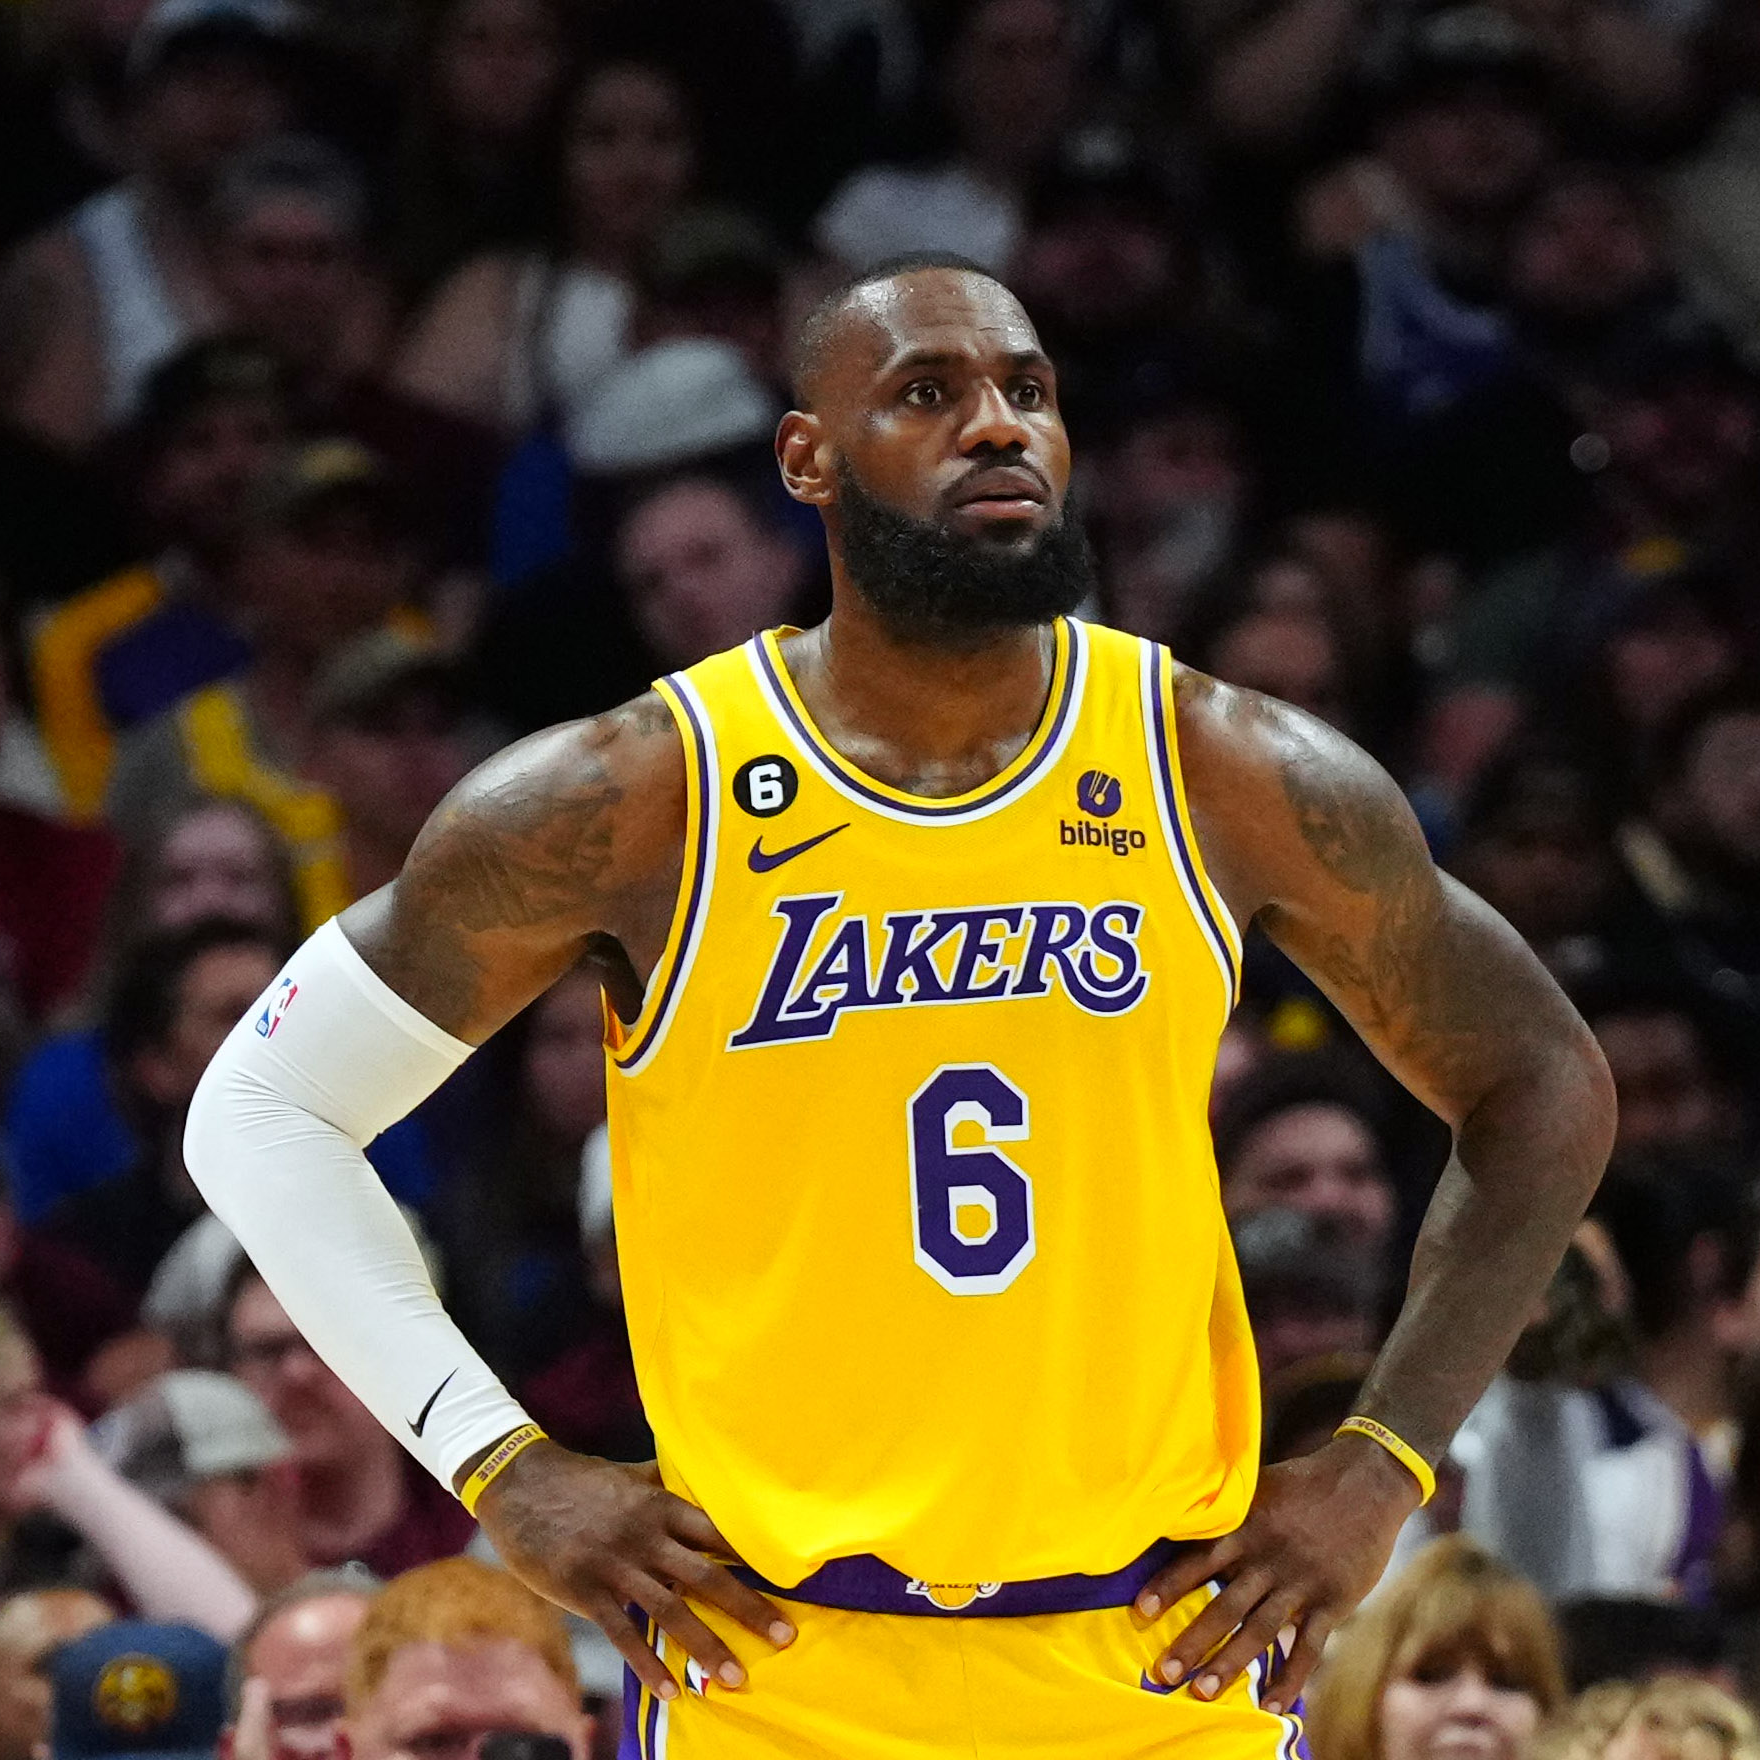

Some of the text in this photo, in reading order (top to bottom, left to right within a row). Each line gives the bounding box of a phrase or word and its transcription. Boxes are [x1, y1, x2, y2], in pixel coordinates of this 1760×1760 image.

[747, 763, 785, 811] 6
[1059, 820, 1147, 857] bibigo
[725, 889, 1151, 1054] LAKERS
[906, 1062, 1037, 1296] 6
[476, 1428, 534, 1483] PROMISE
